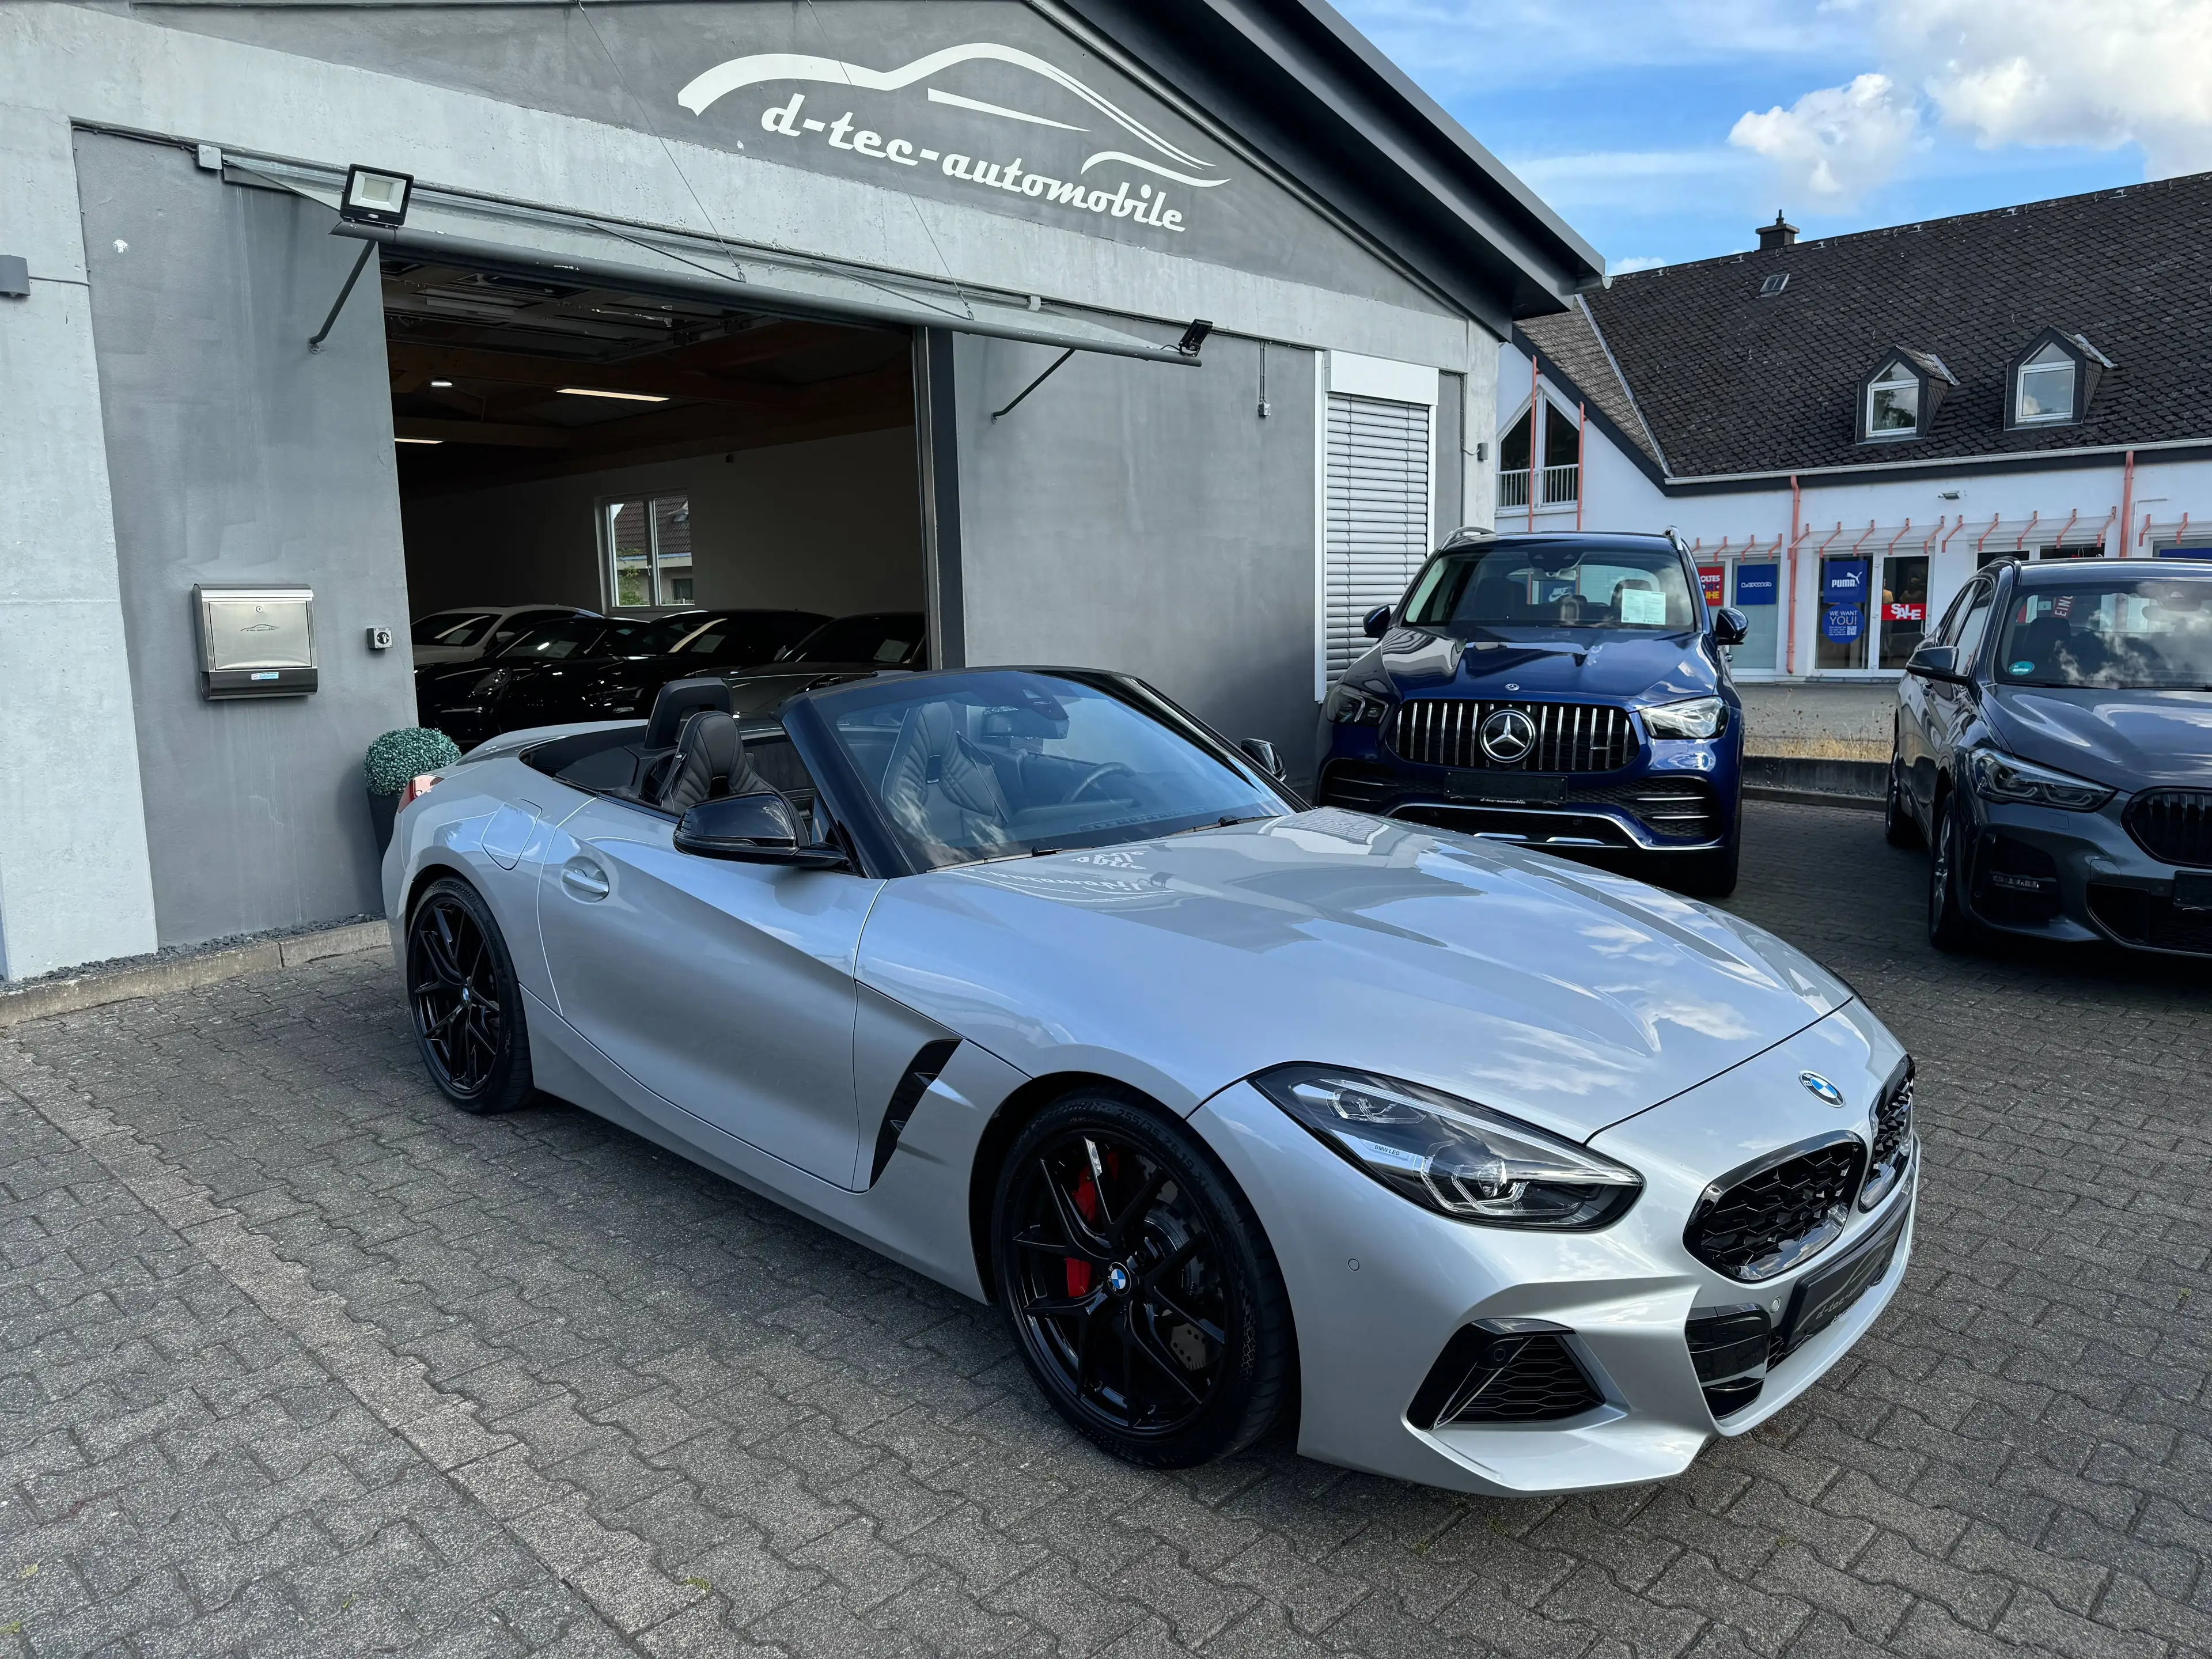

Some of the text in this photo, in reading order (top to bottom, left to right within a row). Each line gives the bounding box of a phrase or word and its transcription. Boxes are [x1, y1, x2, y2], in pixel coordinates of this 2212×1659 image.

[761, 93, 1186, 232] d-tec-automobile
[1832, 579, 1855, 588] PUMA
[1891, 603, 1921, 620] SALE
[1830, 616, 1857, 625] YOU!
[1117, 1108, 1160, 1138] 255/35
[1180, 1155, 1195, 1171] 19
[1374, 1145, 1388, 1153] BMW
